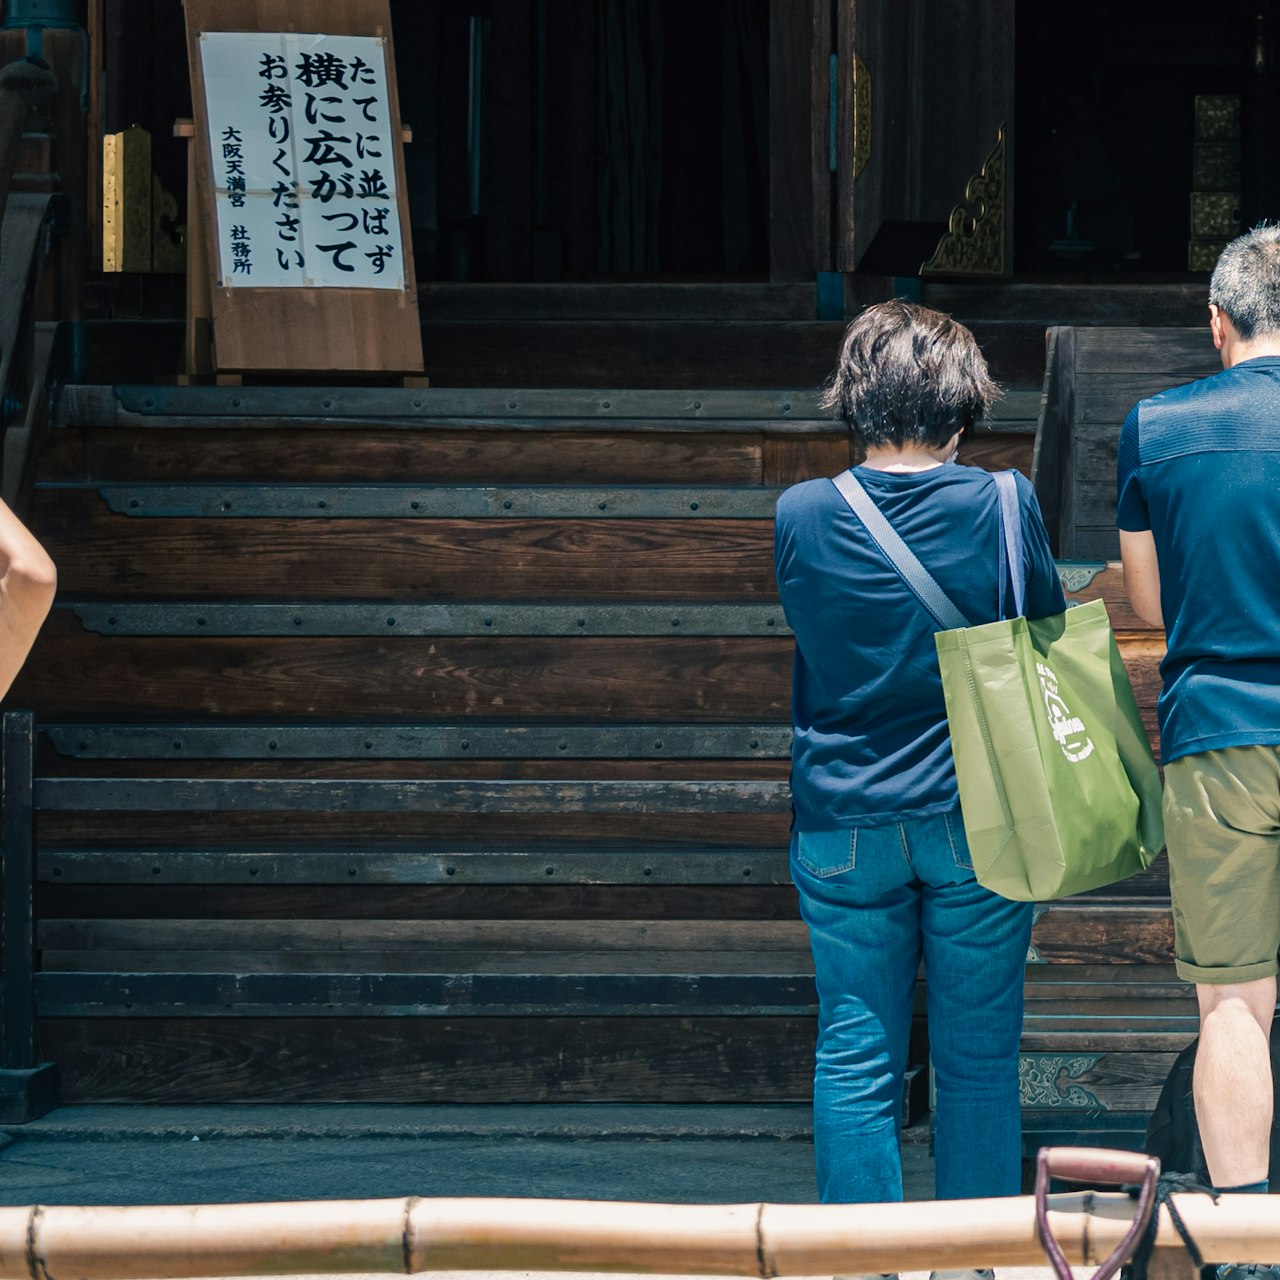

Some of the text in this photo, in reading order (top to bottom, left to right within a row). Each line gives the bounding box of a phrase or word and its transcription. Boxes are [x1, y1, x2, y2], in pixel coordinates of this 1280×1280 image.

[221, 125, 254, 275] 大阪天満宮 社務所
[258, 52, 305, 272] お参りください
[295, 51, 360, 273] 横に広がって
[348, 55, 396, 275] たてに並ばず
